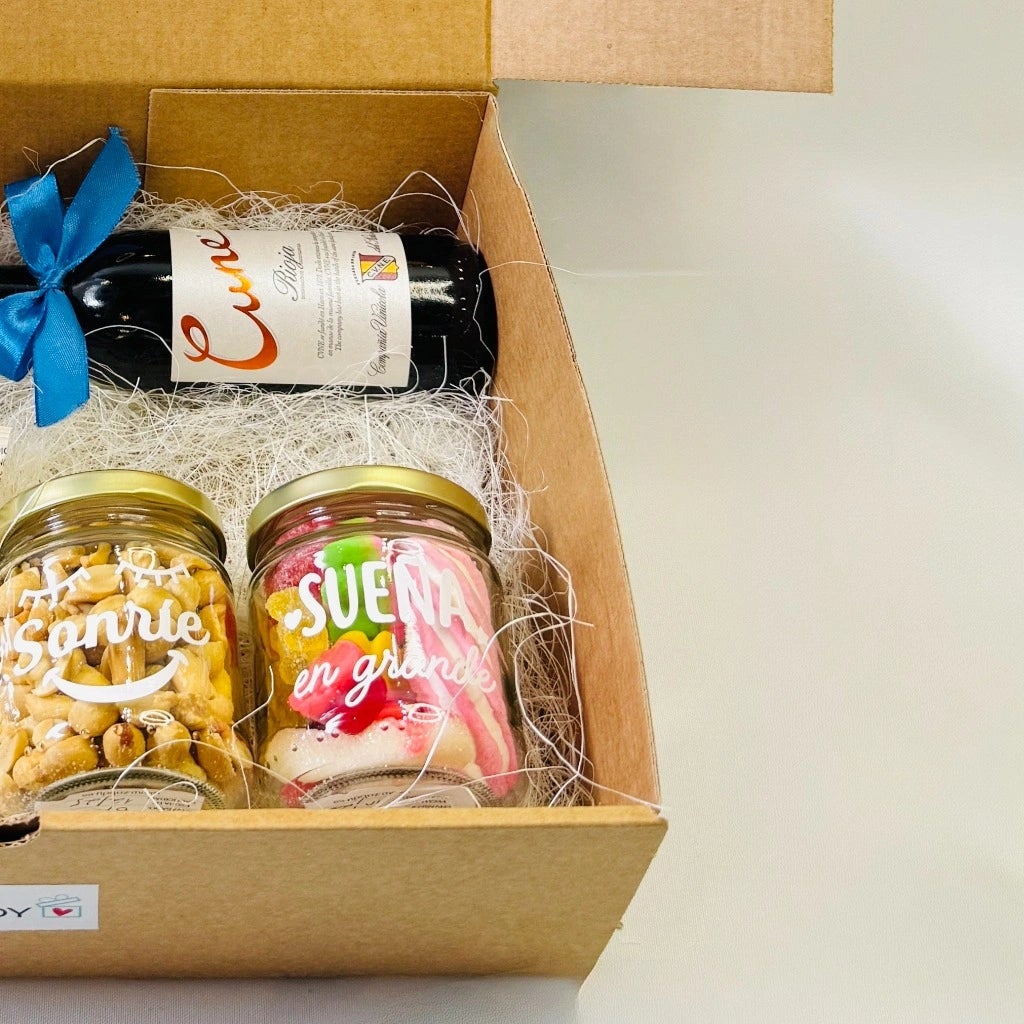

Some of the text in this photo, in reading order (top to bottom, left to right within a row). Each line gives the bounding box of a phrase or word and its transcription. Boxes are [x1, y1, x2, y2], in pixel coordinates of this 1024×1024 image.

[272, 245, 304, 302] Rioja
[294, 646, 497, 707] en grande
